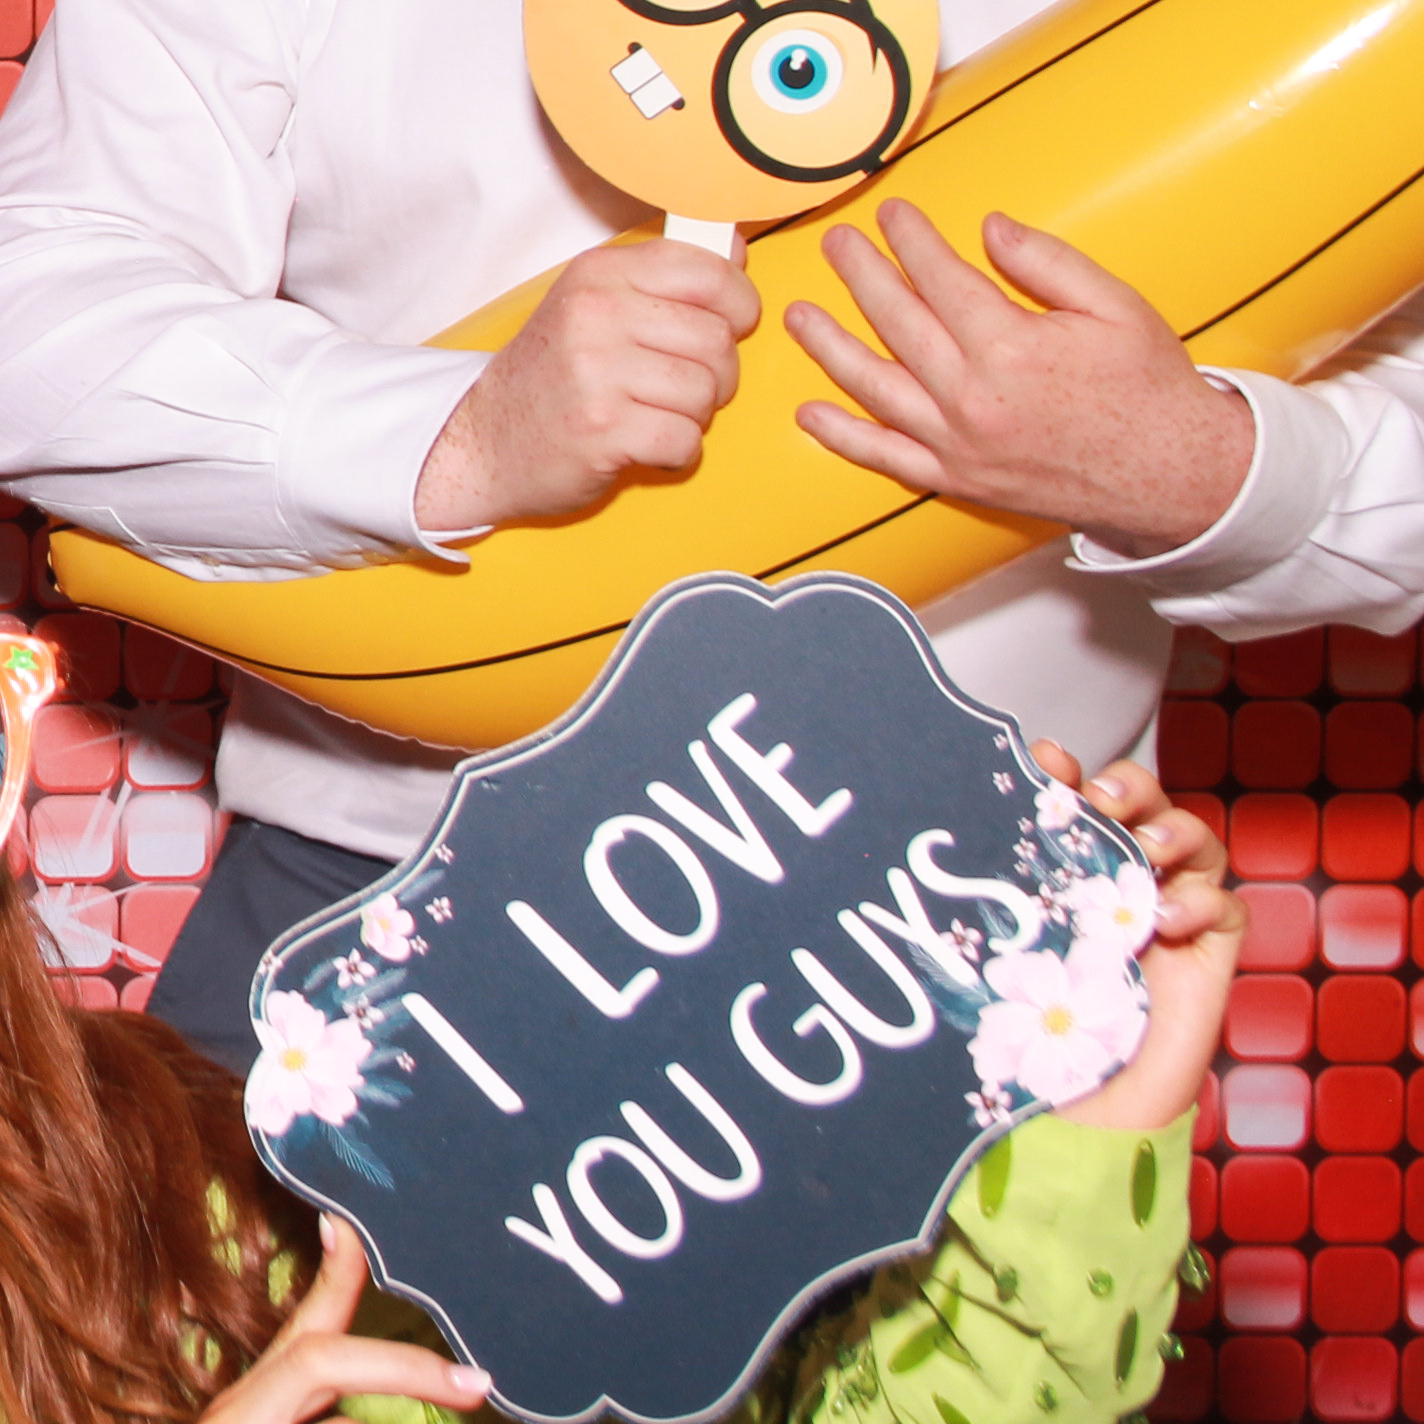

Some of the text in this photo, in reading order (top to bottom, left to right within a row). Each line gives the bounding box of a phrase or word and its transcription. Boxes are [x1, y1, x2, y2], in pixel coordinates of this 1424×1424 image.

[401, 692, 854, 1114] I LOVE
[504, 828, 1043, 1306] YOU GUYS
